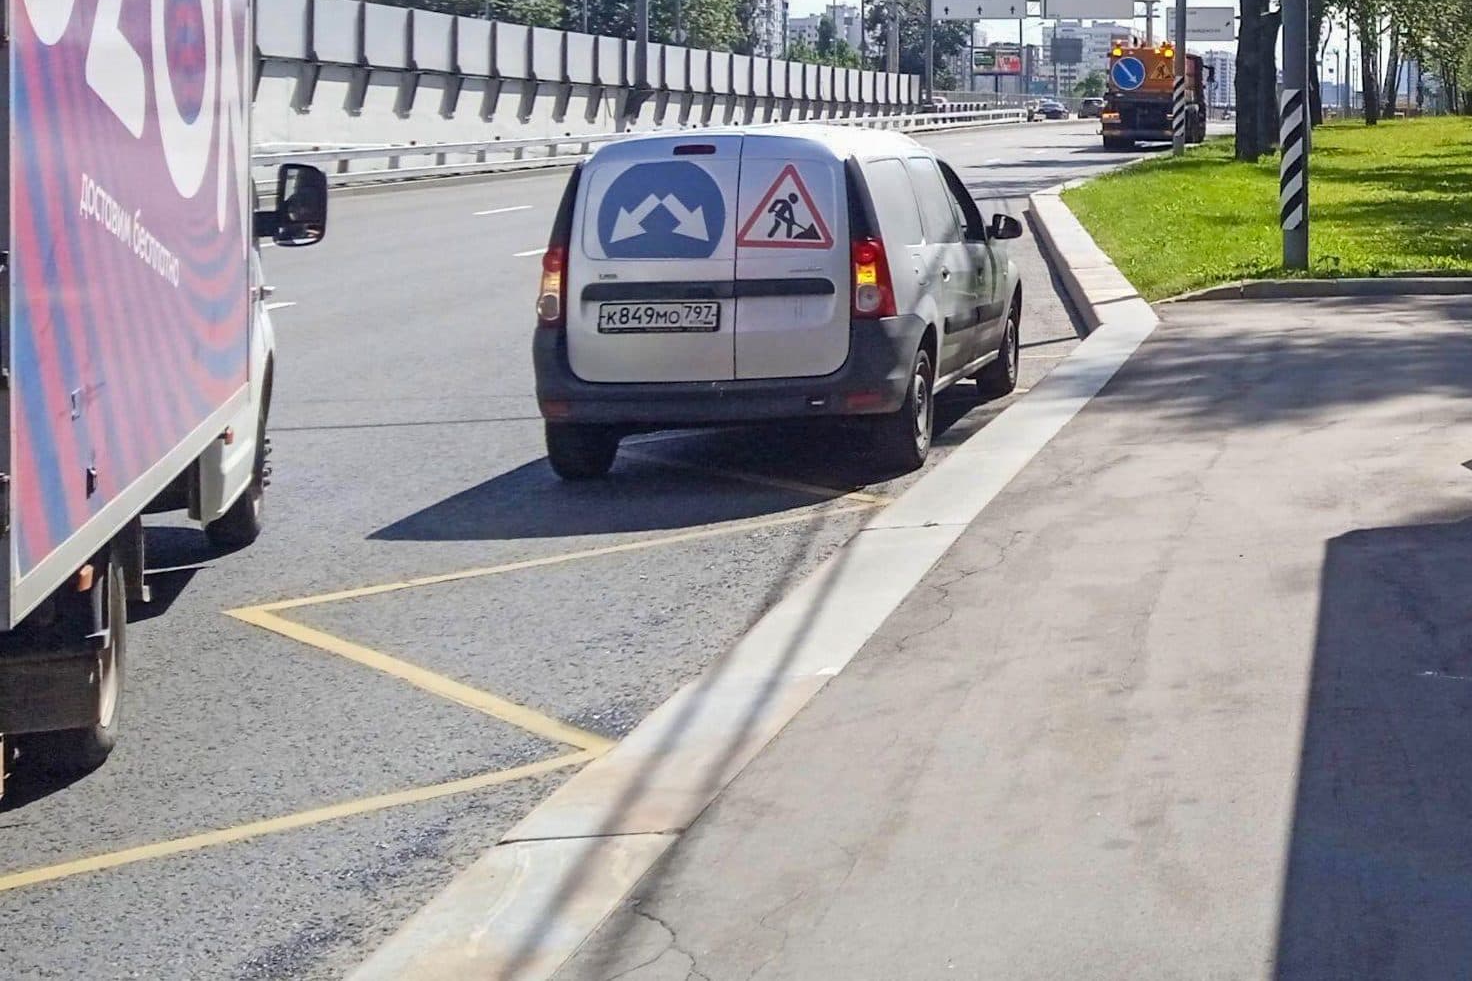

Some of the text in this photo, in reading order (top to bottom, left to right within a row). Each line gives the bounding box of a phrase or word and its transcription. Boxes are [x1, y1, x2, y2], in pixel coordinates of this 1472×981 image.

[79, 172, 180, 288] доставим бесплатно
[606, 305, 713, 325] К849МО 797
